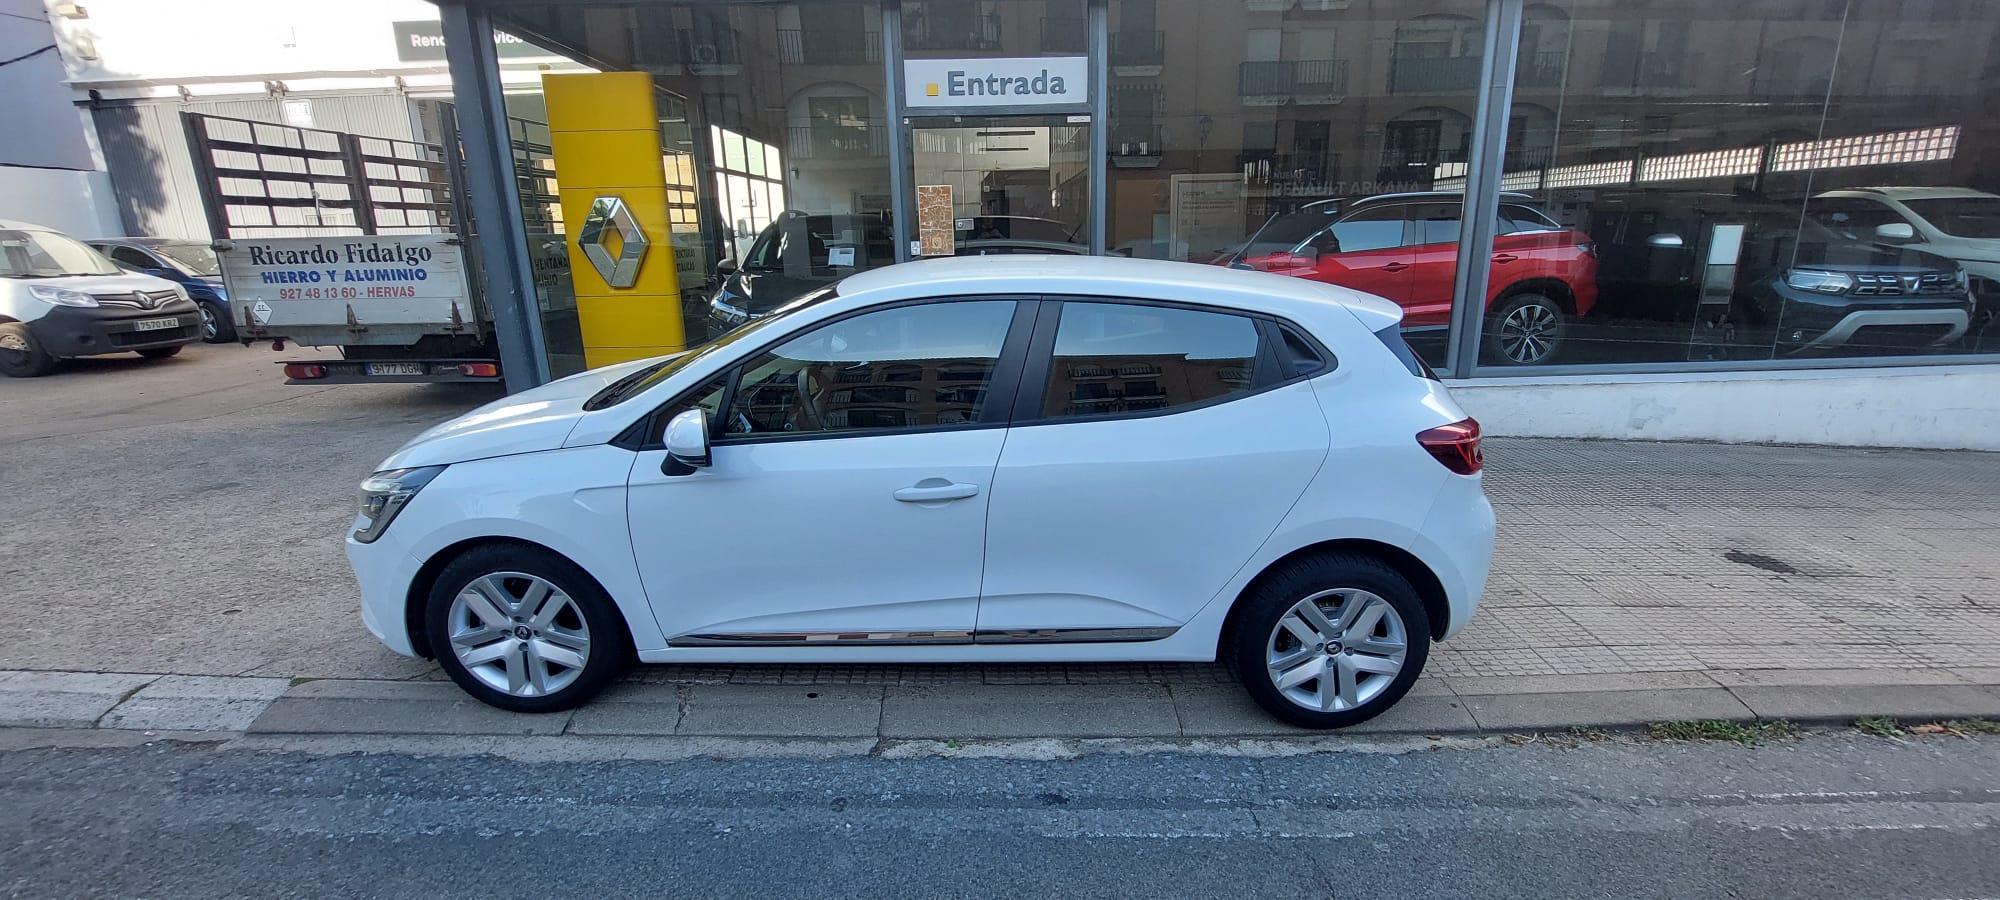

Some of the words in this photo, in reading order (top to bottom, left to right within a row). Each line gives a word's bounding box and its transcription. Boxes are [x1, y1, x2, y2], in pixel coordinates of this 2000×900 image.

[947, 69, 1067, 97] Entrada
[1272, 181, 1346, 196] RENAULT
[1350, 180, 1419, 195] ARKANA
[248, 244, 339, 266] Ricardo
[344, 242, 432, 267] Fidalgo
[261, 270, 321, 284] HIERRO
[325, 270, 337, 283] Y
[344, 268, 428, 282] ALUMINIO
[279, 288, 302, 299] 927
[305, 288, 321, 298] 48
[325, 287, 338, 298] 13
[341, 287, 357, 298] 60
[367, 286, 415, 298] HERVAS
